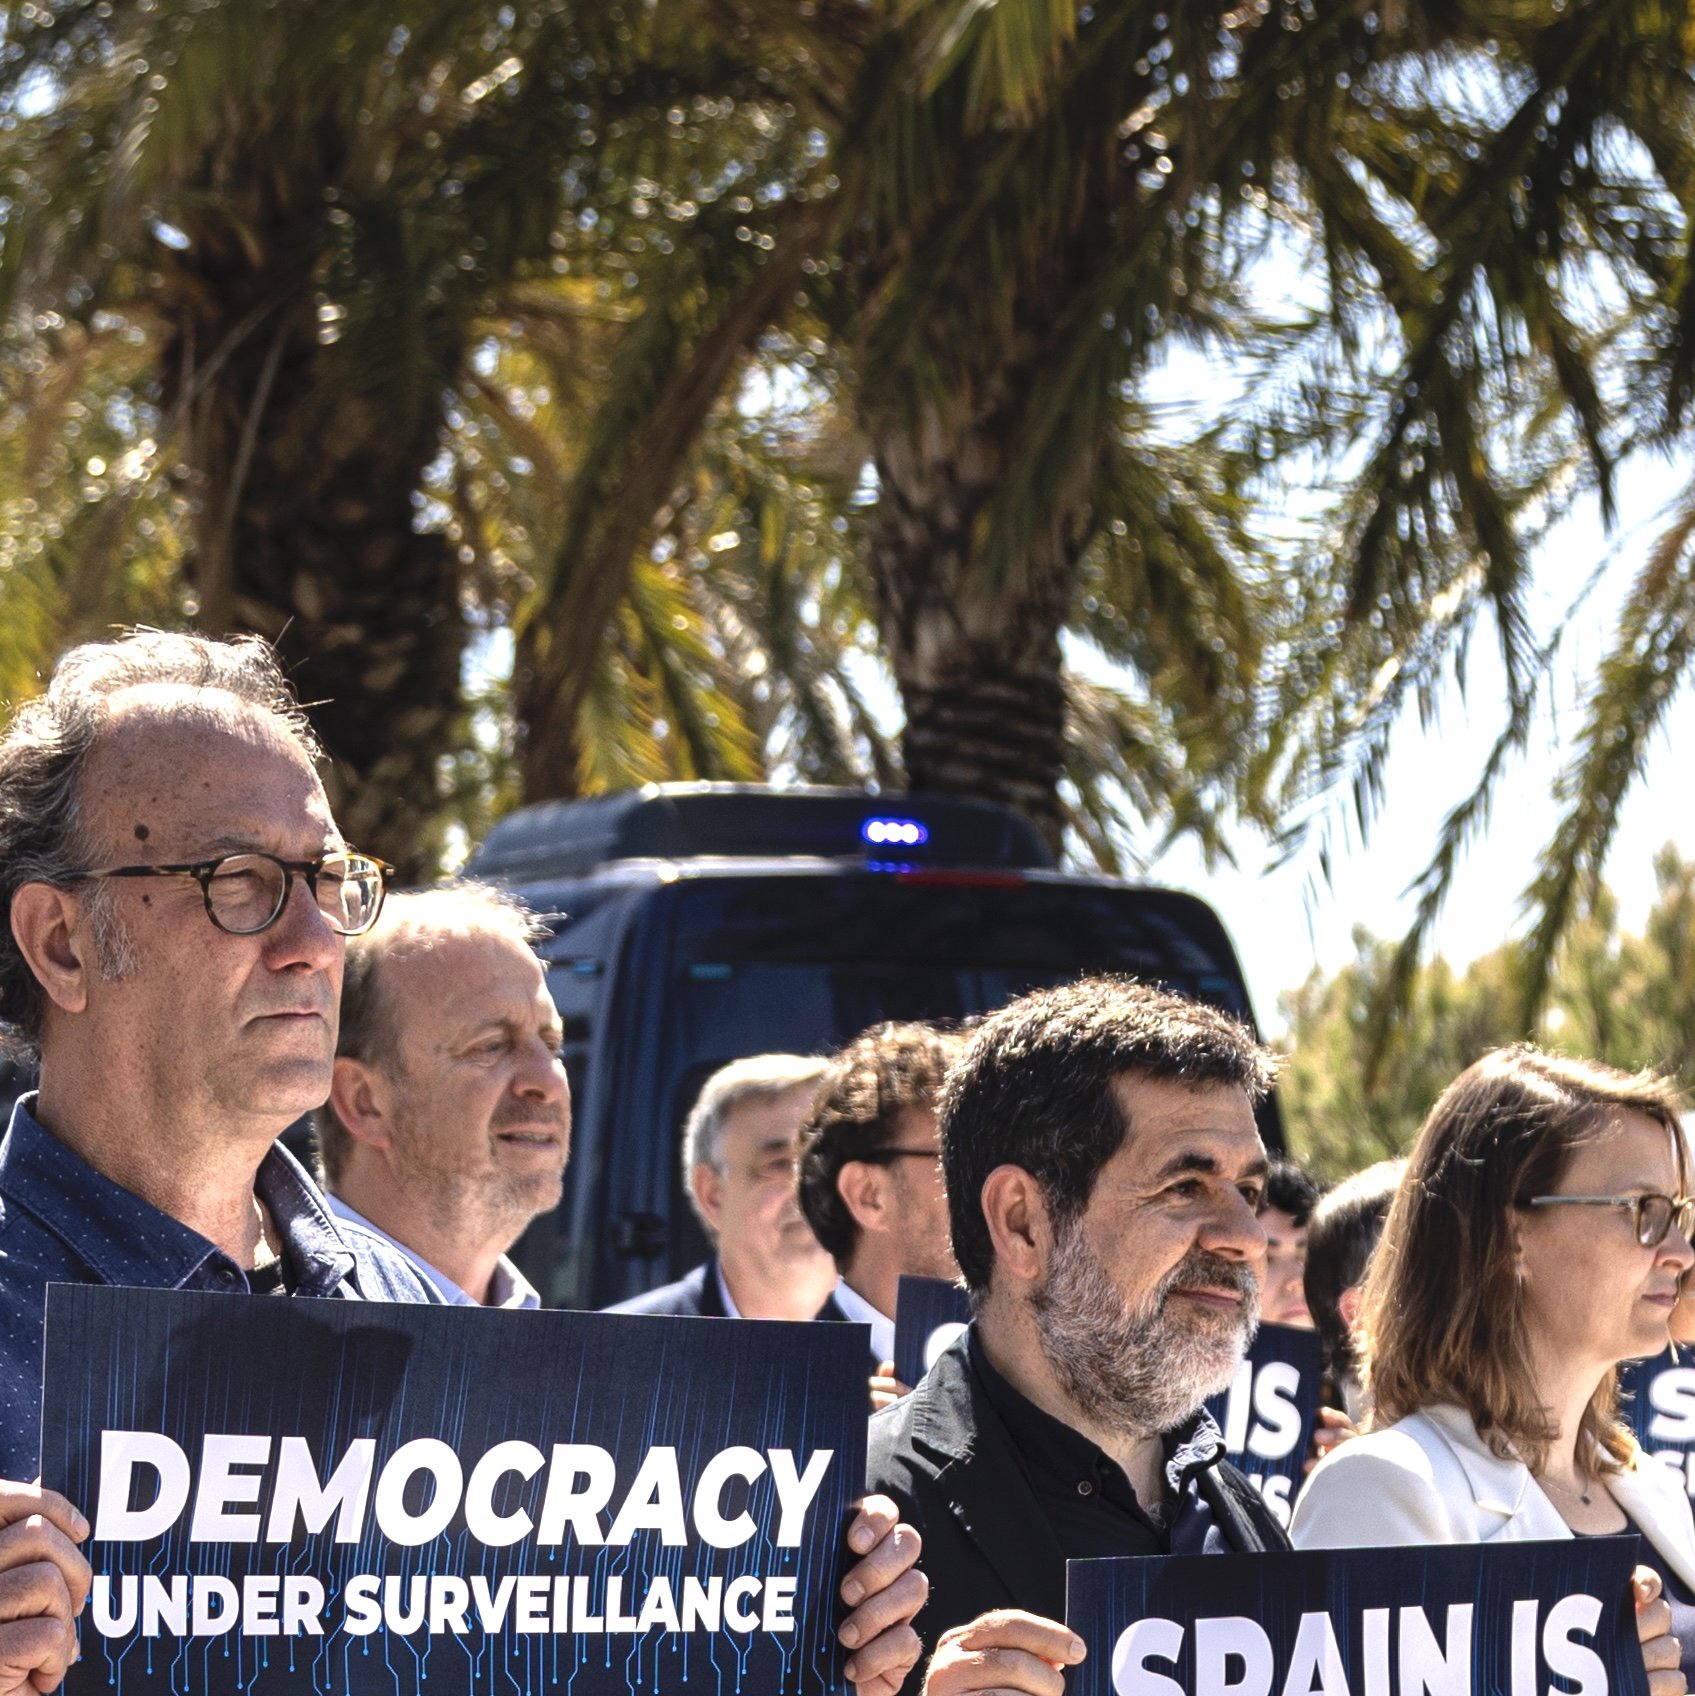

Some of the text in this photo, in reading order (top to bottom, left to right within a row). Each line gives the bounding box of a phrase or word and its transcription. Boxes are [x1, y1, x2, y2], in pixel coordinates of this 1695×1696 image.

[1225, 1360, 1302, 1461] IS
[92, 1429, 835, 1548] DEMOCRACY
[91, 1573, 796, 1639] UNDER SURVEILLANCE
